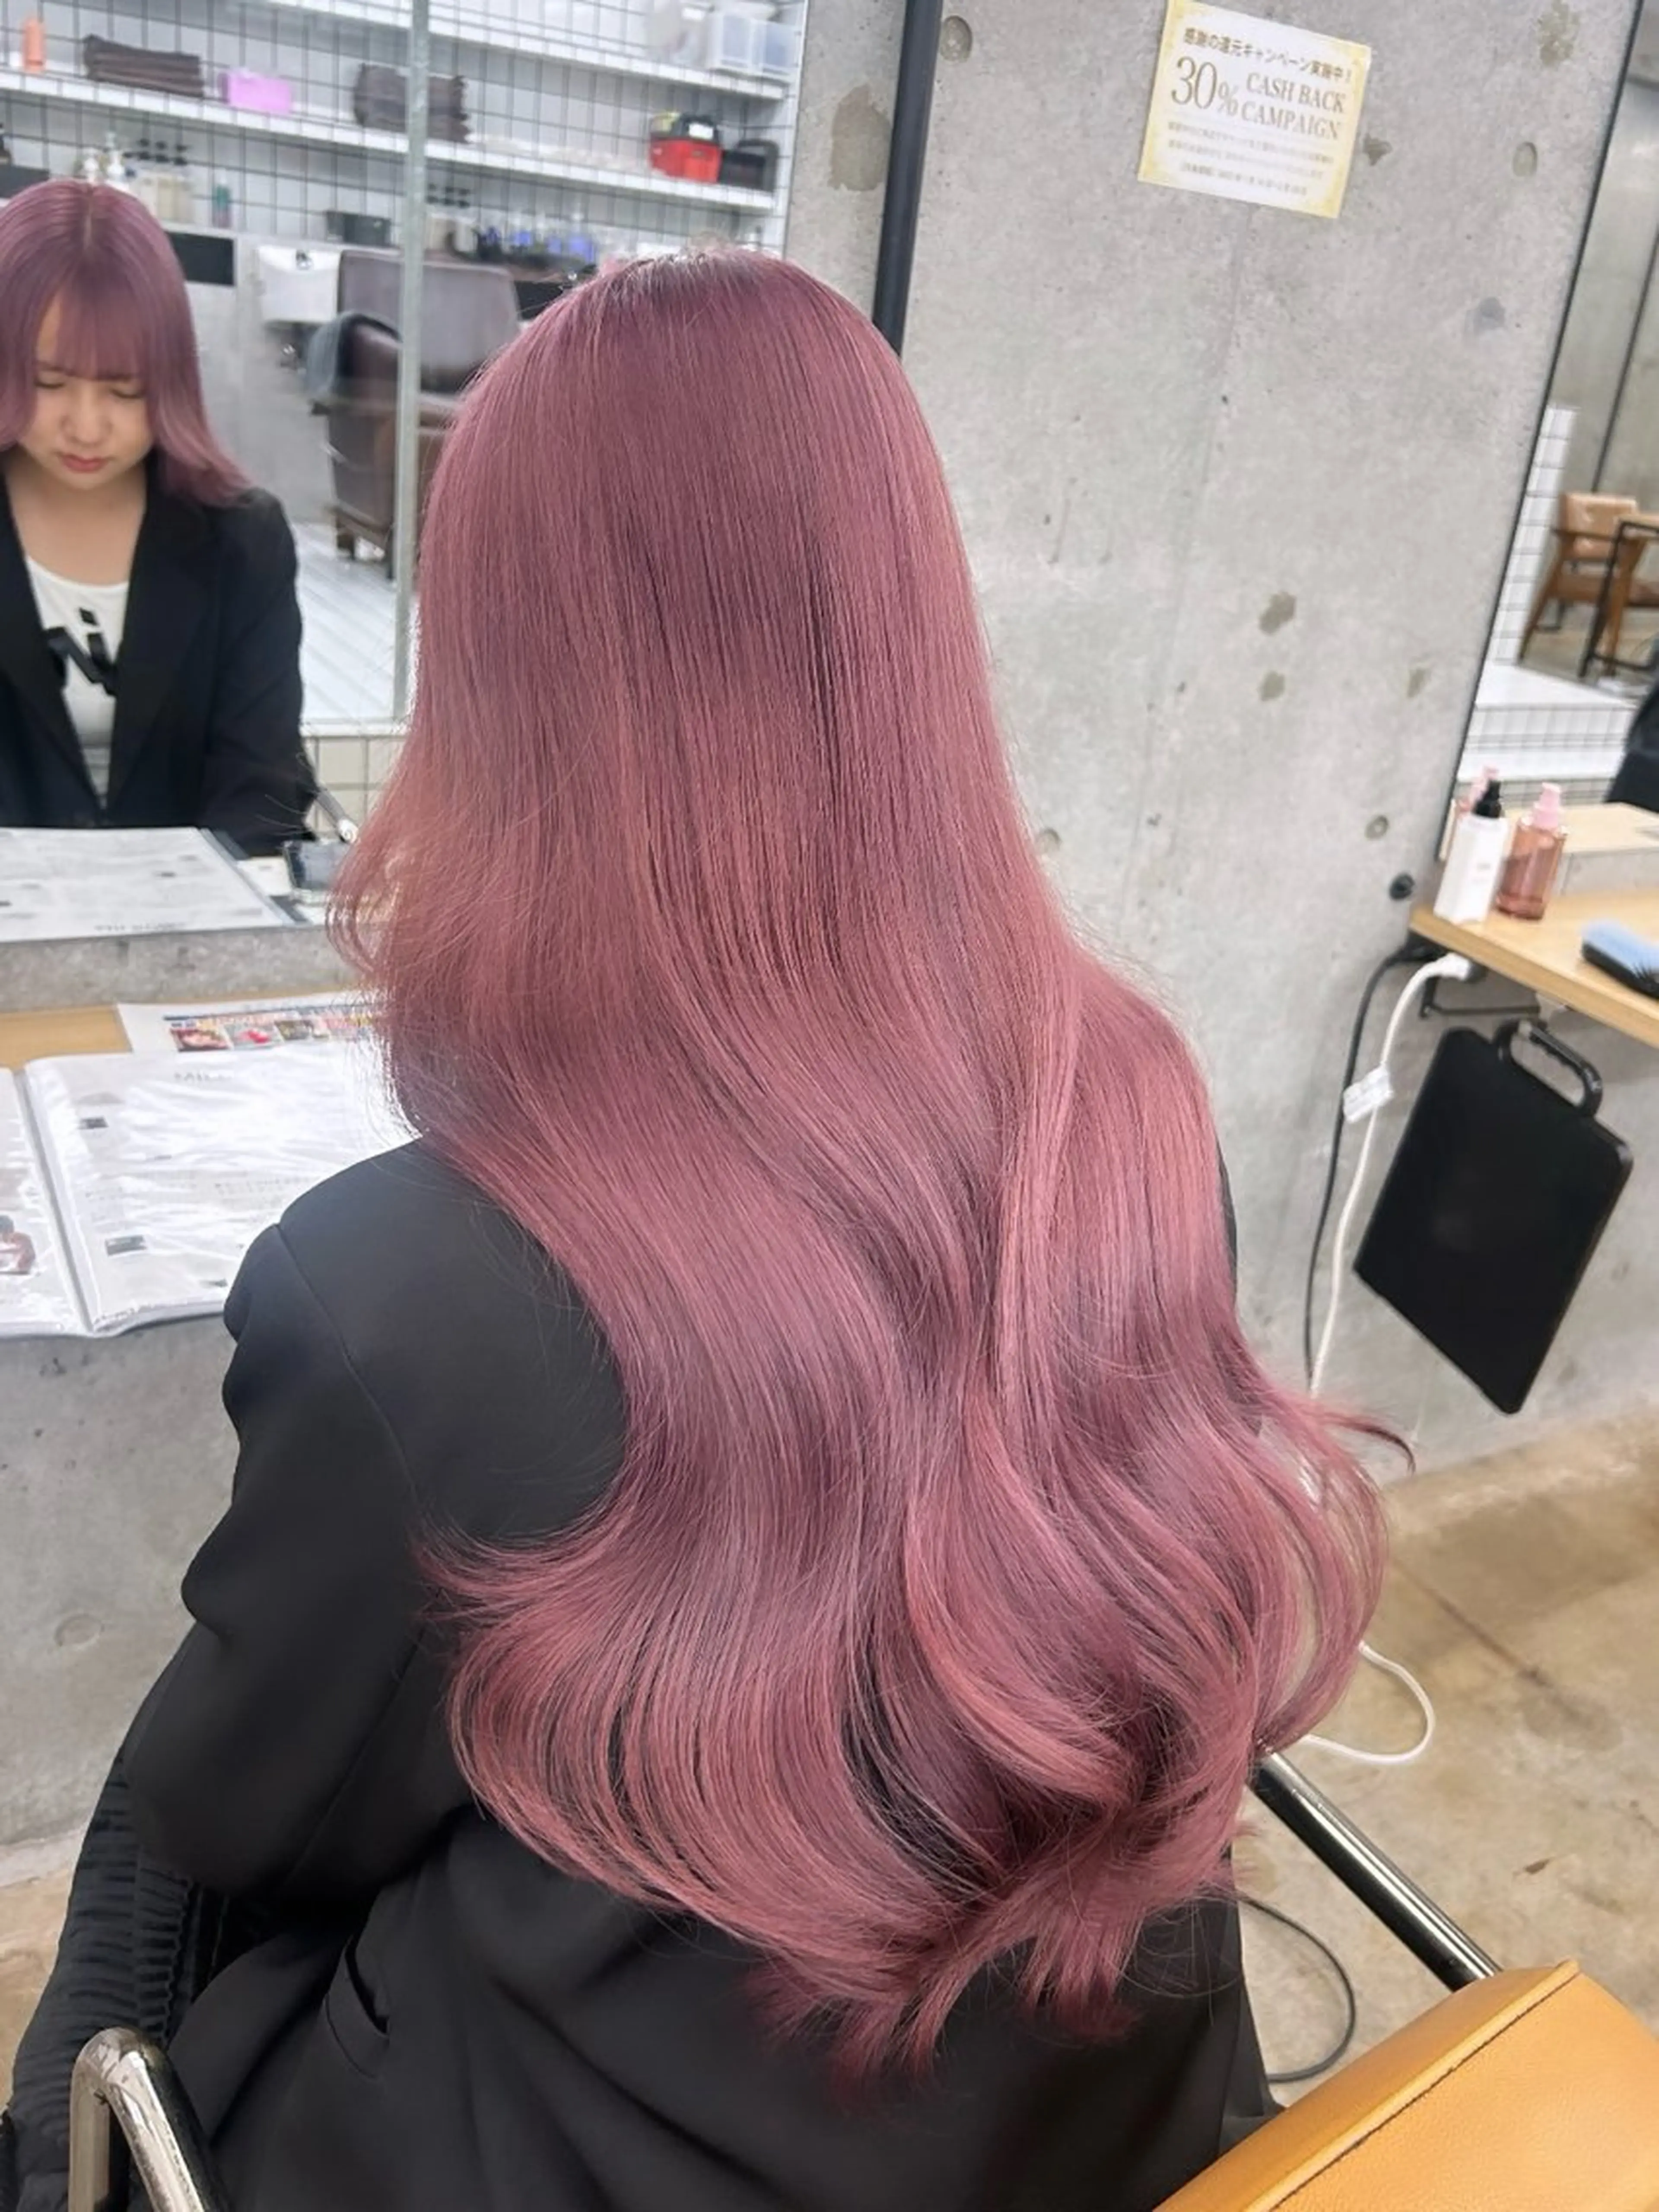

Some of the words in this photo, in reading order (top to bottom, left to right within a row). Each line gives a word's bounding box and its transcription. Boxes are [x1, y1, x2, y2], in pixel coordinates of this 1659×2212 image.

[1171, 56, 1239, 116] 30%
[1246, 72, 1294, 103] CASH
[1298, 83, 1346, 113] BACK
[1241, 100, 1340, 140] CAMPAIGN
